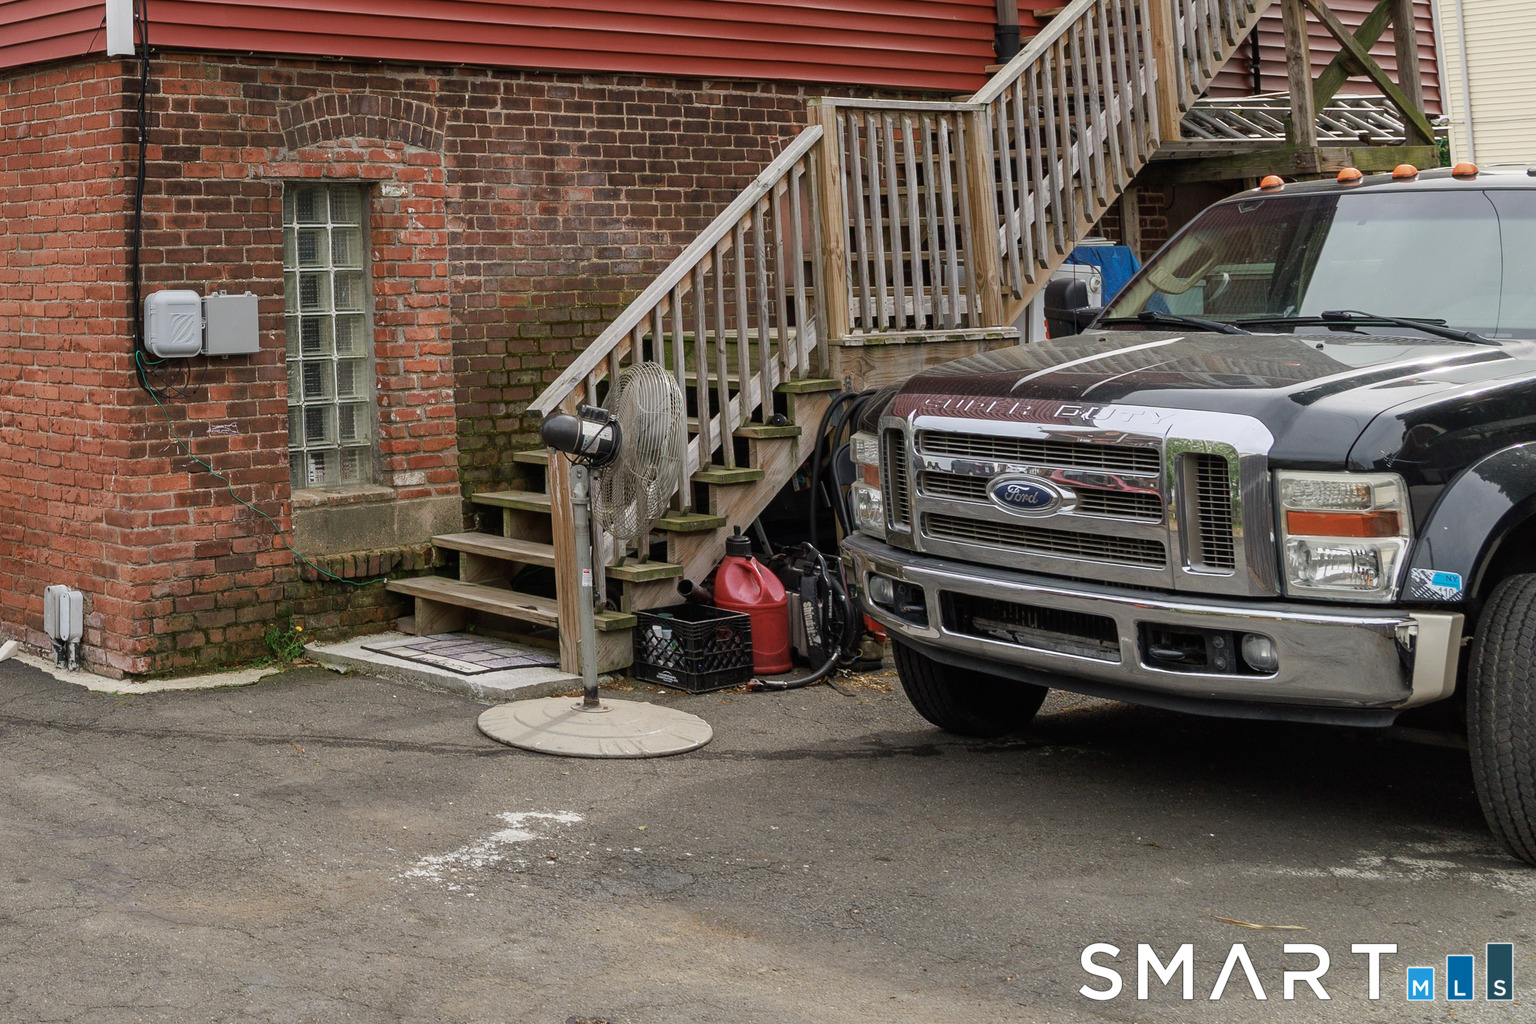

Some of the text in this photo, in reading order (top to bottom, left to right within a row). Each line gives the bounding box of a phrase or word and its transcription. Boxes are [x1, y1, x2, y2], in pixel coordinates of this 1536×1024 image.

[924, 398, 1176, 424] SUPER DUTY
[1004, 484, 1039, 505] Ford
